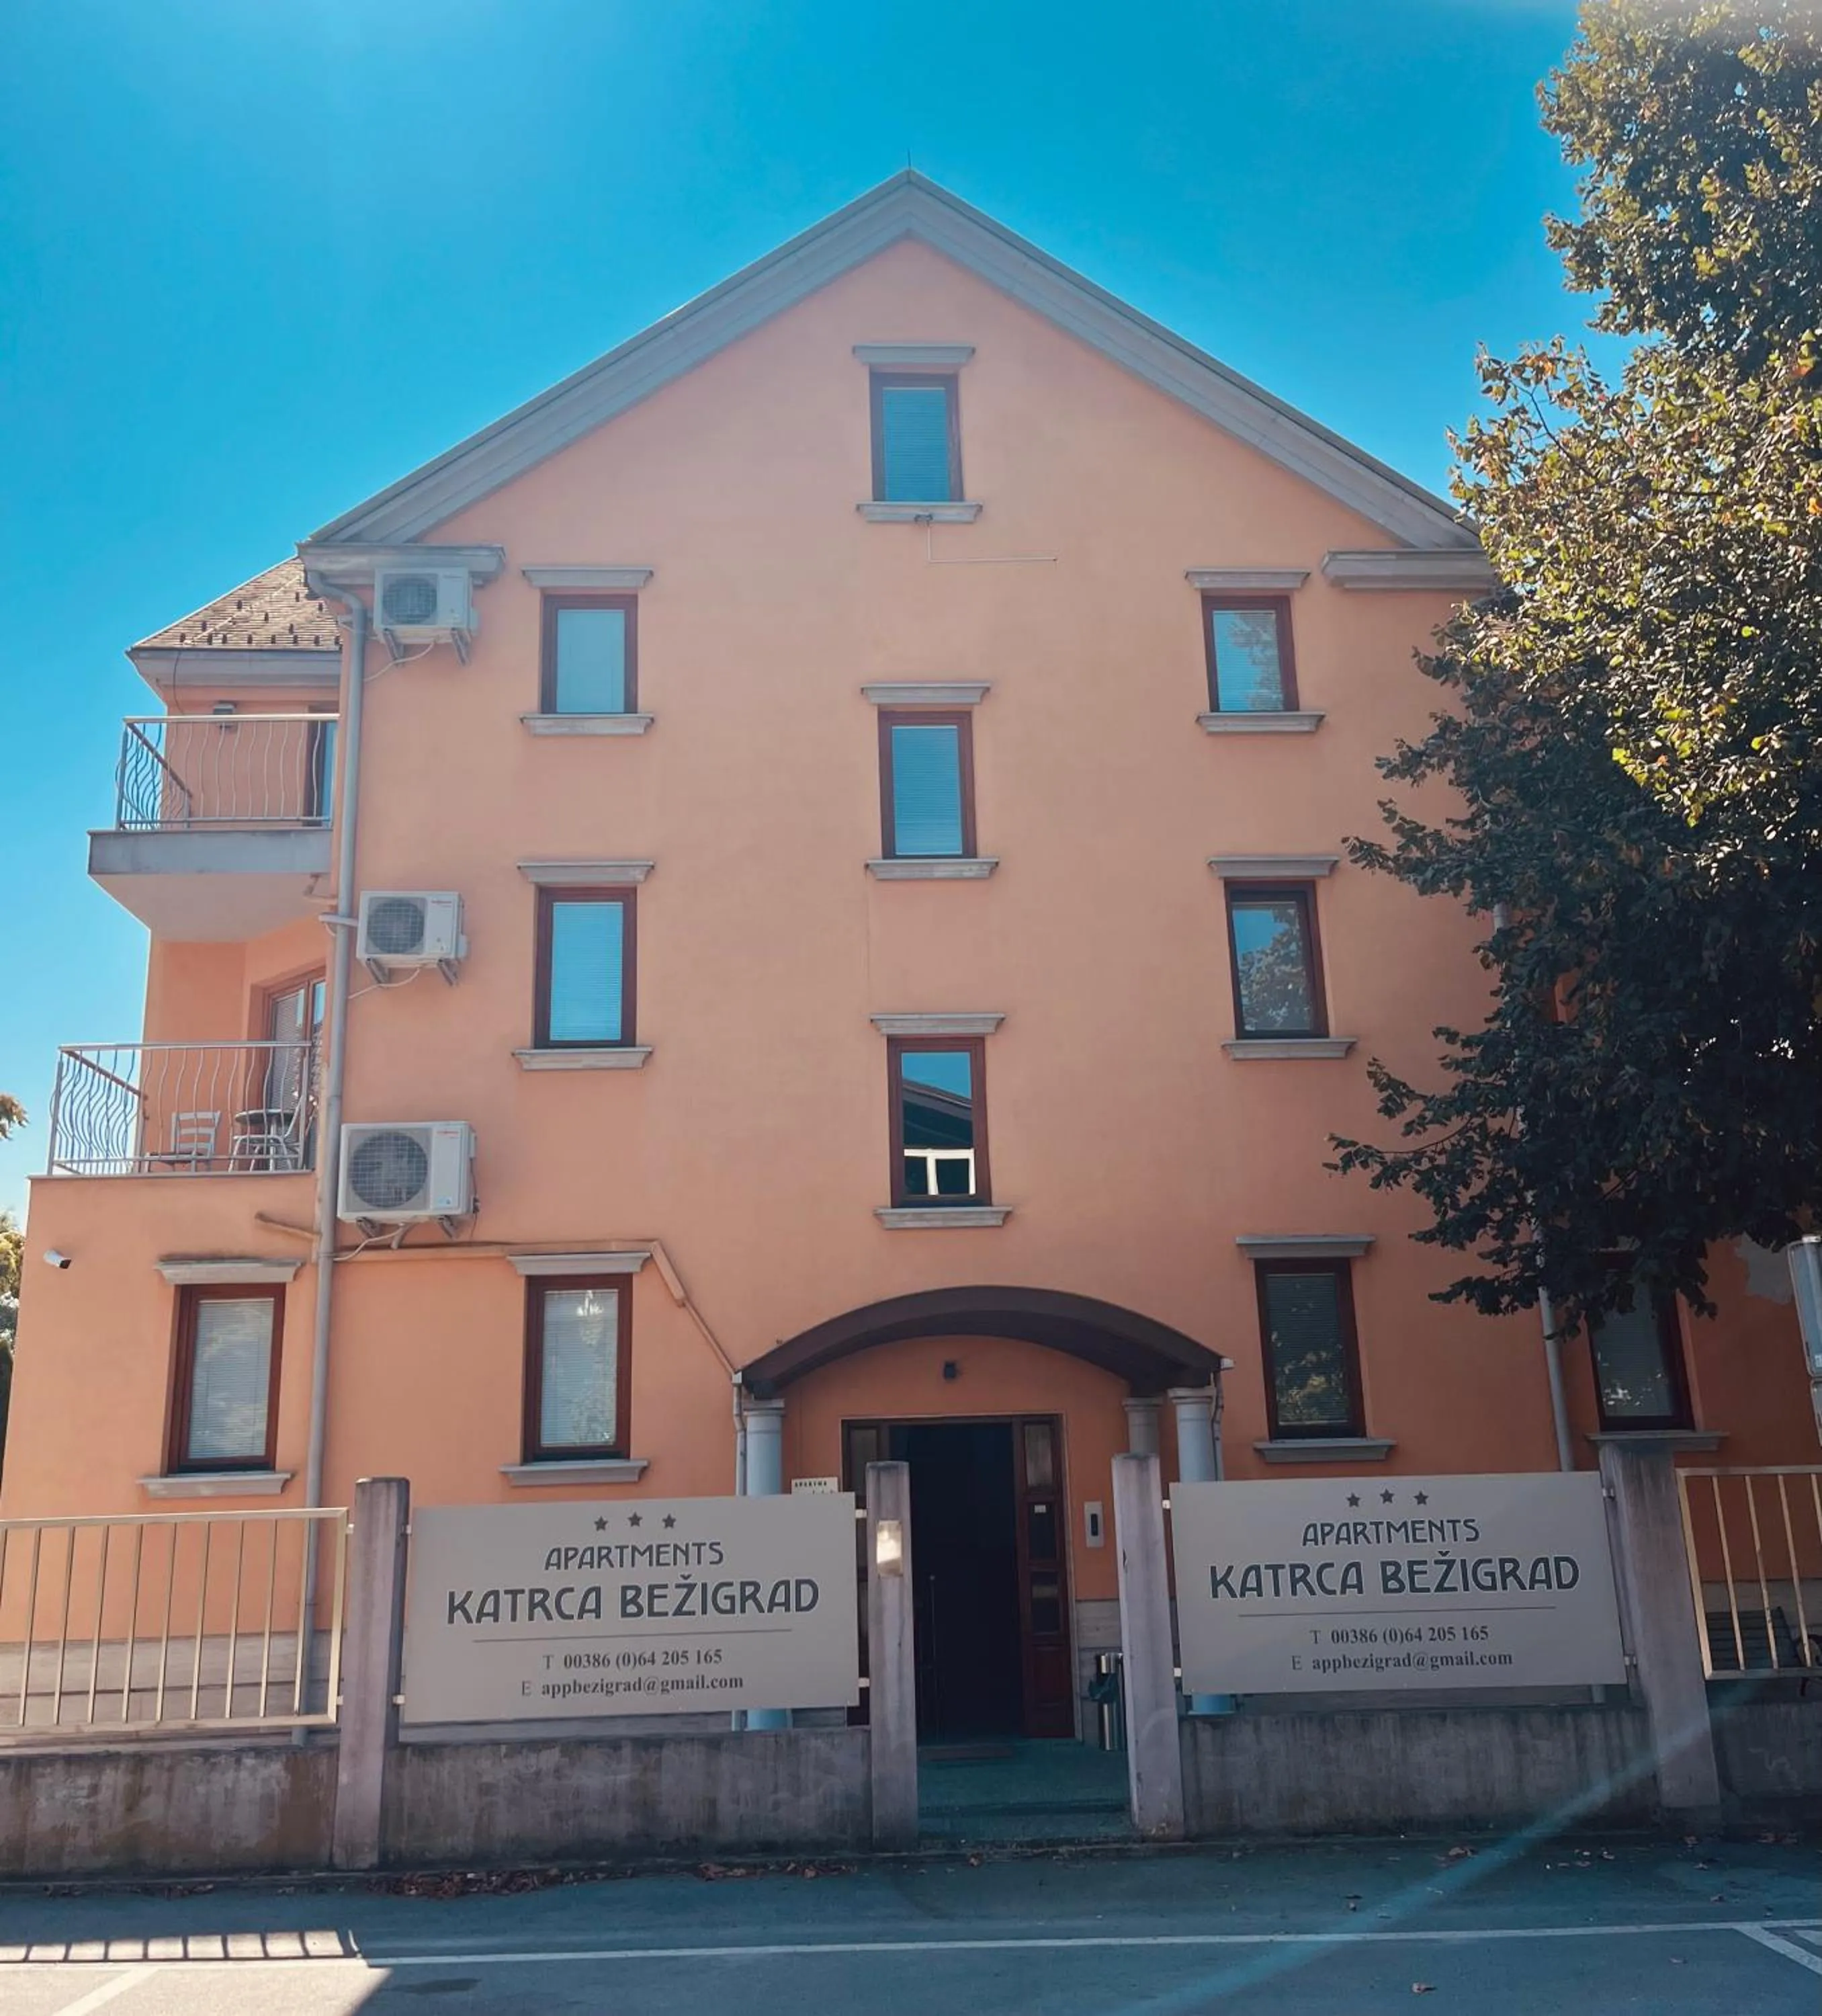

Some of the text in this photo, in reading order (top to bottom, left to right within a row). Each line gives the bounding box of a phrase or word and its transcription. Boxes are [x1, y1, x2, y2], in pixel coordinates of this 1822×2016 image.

[1302, 1518, 1480, 1547] APARTMENTS
[544, 1541, 724, 1570] APARTMENTS
[1210, 1550, 1580, 1599] KATRCA BEŽIGRAD
[447, 1573, 820, 1625] KATRCA BEŽIGRAD
[1309, 1625, 1489, 1645] T 00386 (0)64 205 165
[542, 1648, 723, 1671] T 00386 (0)64 205 165
[1291, 1650, 1513, 1674] E appbezigrad@gmail.com
[521, 1674, 744, 1699] E appbezigrad@gmail.com
